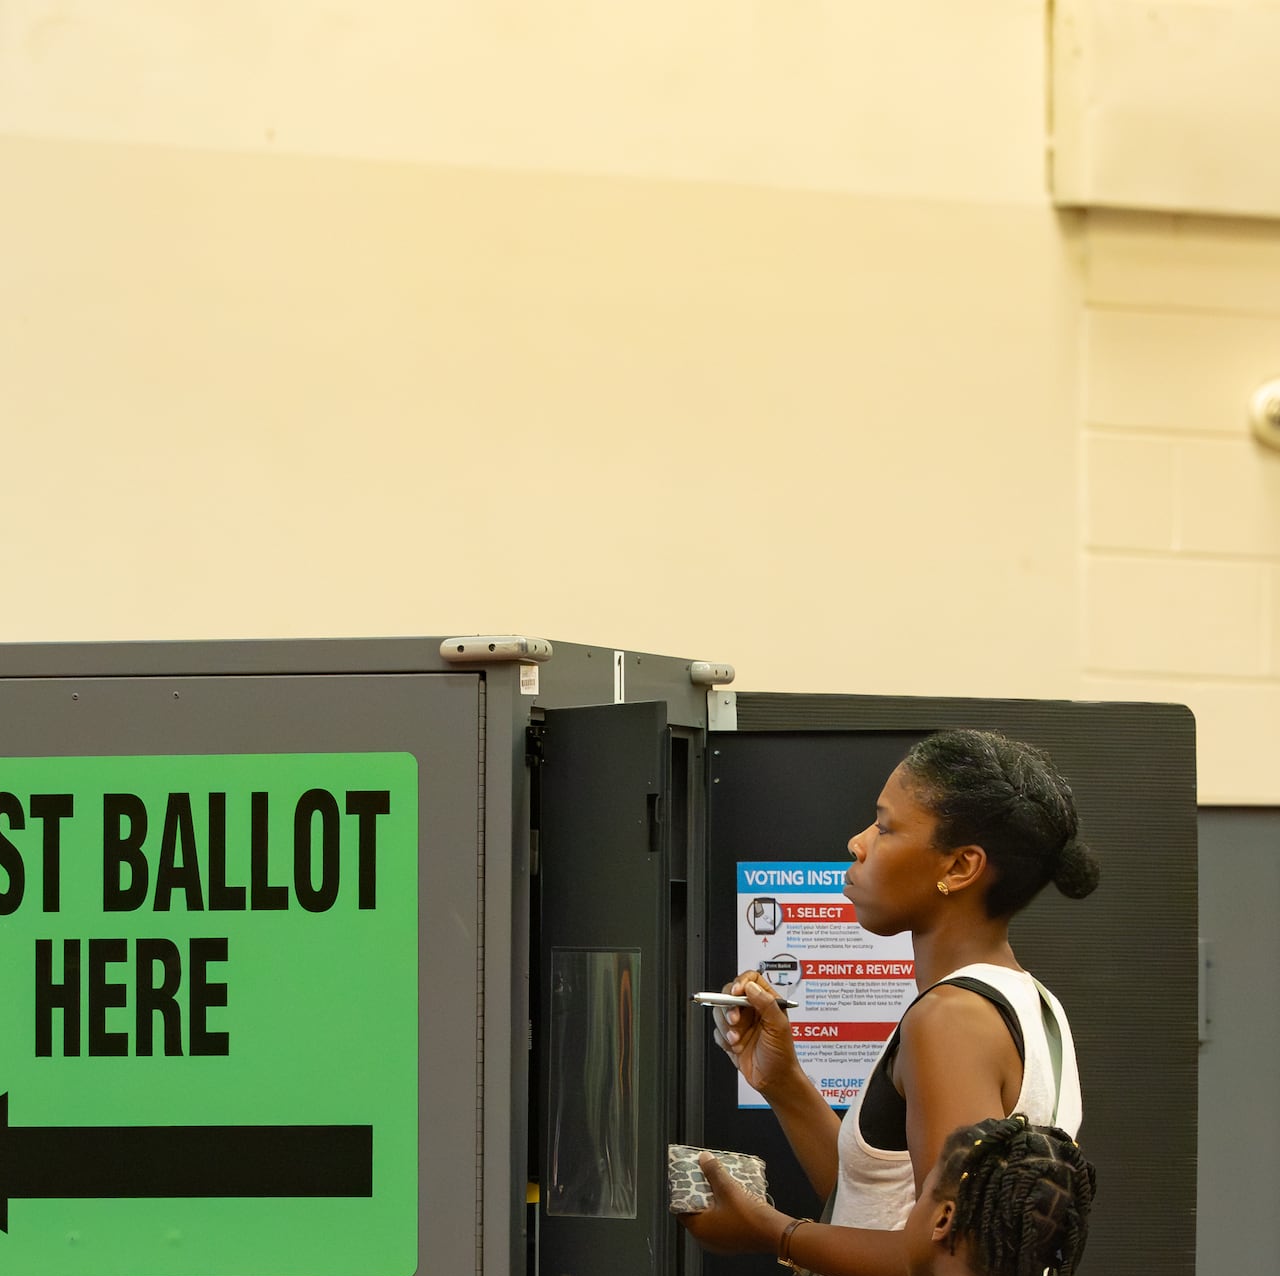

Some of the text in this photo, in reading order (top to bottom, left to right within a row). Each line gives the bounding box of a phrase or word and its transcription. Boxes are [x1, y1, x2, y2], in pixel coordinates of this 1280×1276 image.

[103, 788, 390, 913] BALLOT
[744, 870, 804, 886] VOTING
[787, 907, 843, 918] 1. SELECT
[806, 964, 913, 975] 2. PRINT & REVIEW
[35, 937, 230, 1058] HERE
[792, 1026, 838, 1037] 3. SCAN
[820, 1089, 839, 1097] THE
